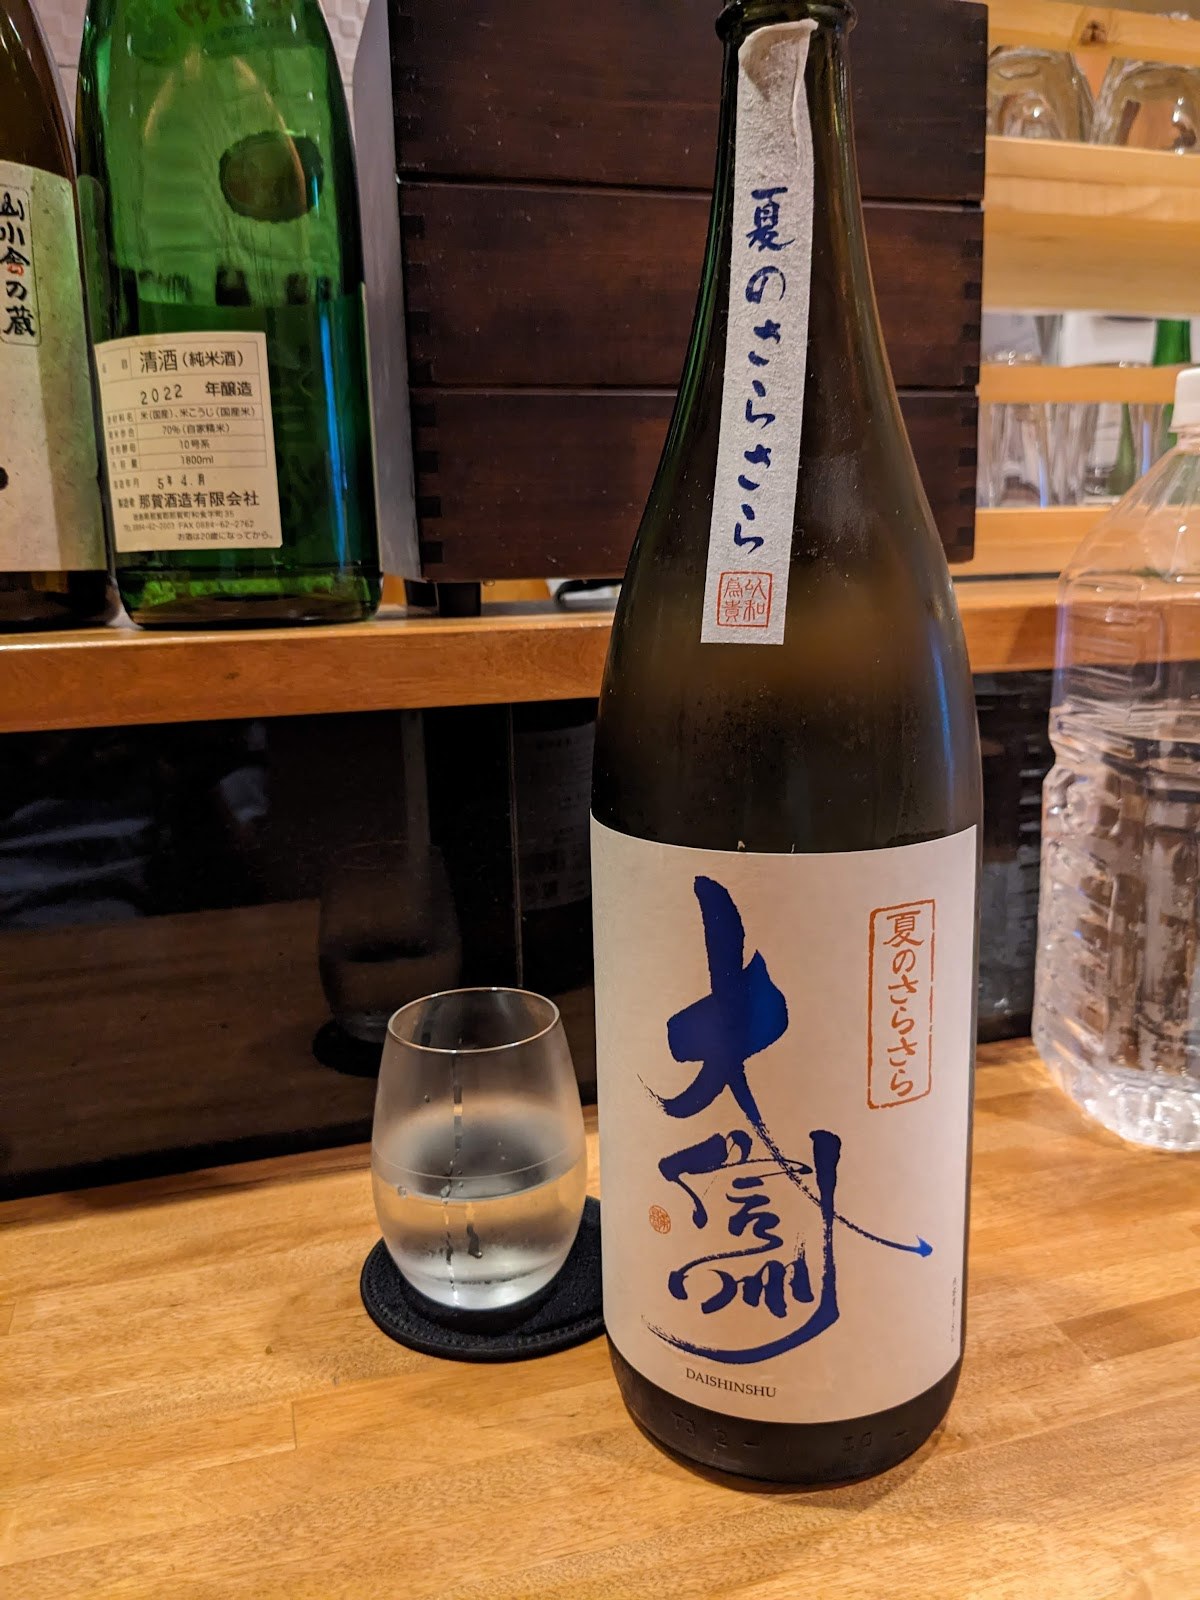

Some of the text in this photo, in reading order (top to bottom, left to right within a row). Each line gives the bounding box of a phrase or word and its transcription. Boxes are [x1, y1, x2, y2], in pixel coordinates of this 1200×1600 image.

[733, 186, 795, 553] 夏のさらさら
[140, 384, 183, 405] 2022
[139, 490, 260, 509] 那賀酒造有限会社
[883, 910, 925, 1097] 夏のさらさら
[686, 1367, 777, 1398] DAISHINSHU
